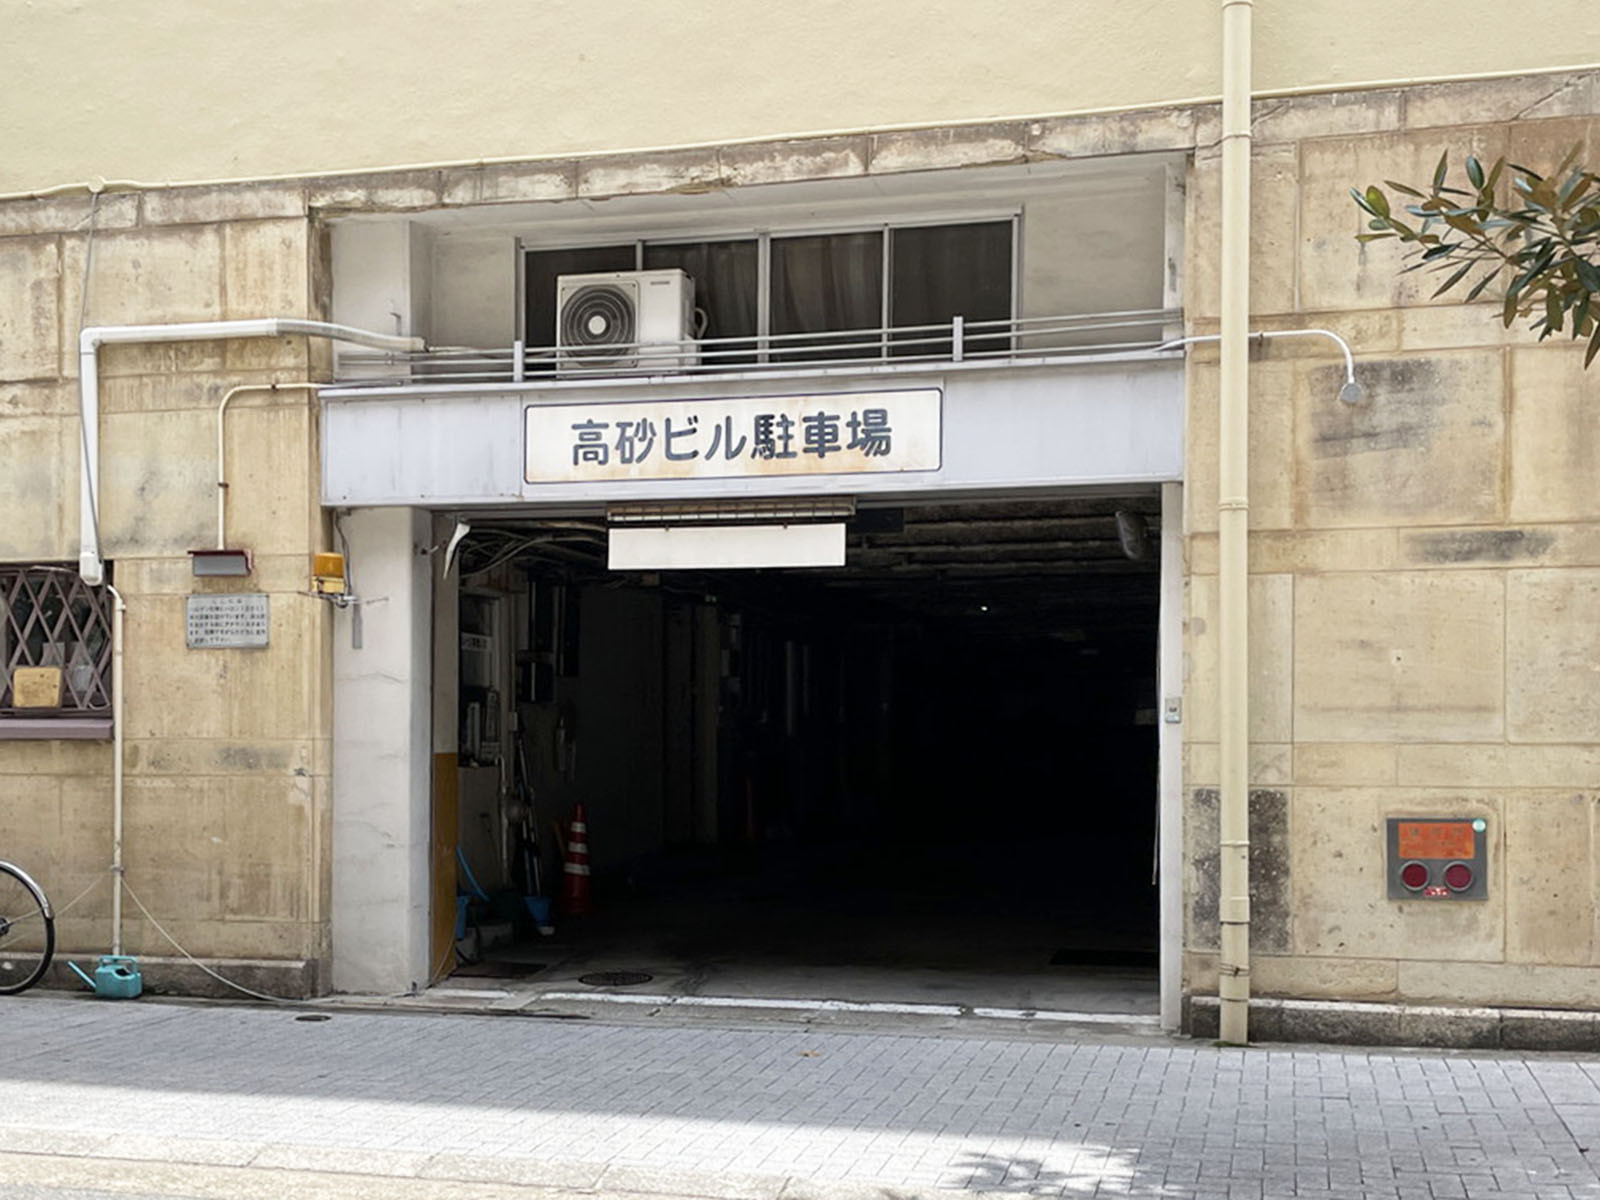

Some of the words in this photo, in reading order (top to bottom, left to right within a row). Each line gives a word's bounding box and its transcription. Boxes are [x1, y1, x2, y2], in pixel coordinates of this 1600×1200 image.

[571, 408, 893, 467] 高砂ビル駐車場
